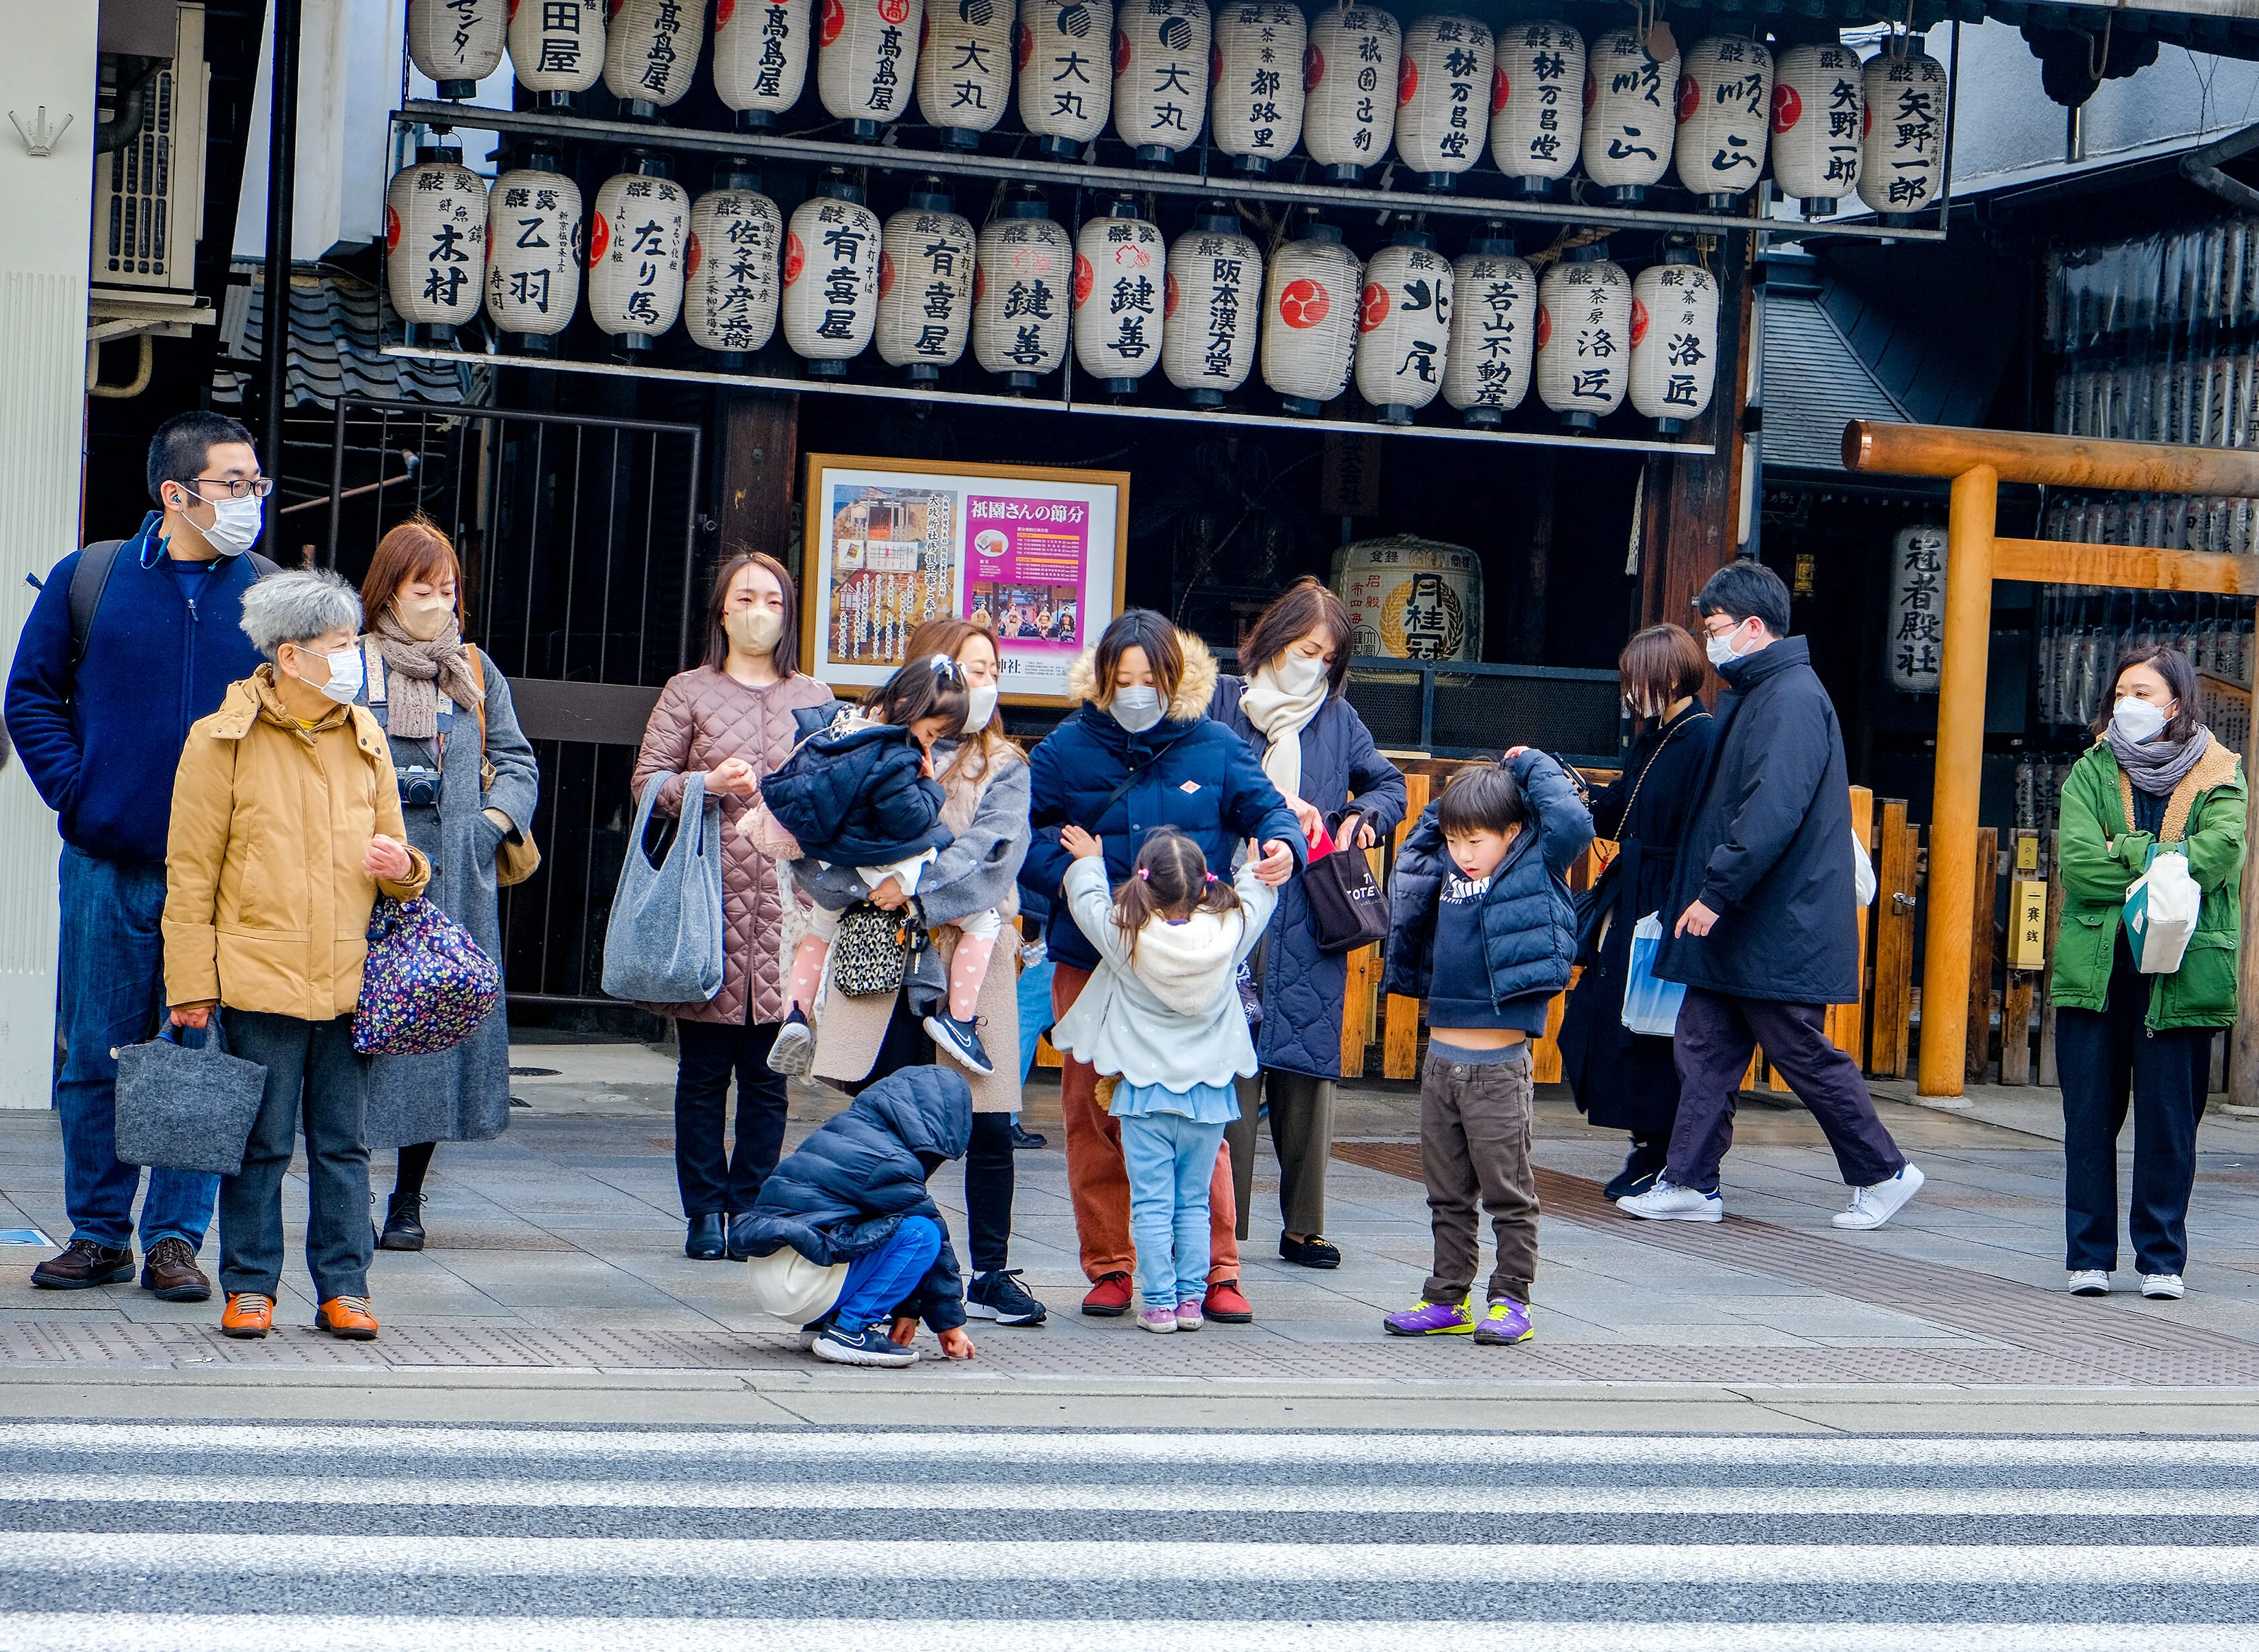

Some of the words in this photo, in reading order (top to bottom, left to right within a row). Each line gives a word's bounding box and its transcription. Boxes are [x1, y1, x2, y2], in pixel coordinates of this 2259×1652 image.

[537, 1, 580, 73] 田屋
[950, 40, 990, 109] 大丸
[1050, 51, 1090, 119] 大丸
[1150, 62, 1190, 131] 大丸
[1440, 47, 1478, 158] 林万昌堂
[1530, 51, 1565, 162] 林万昌堂
[1823, 78, 1859, 188] 矢野一郎
[1888, 88, 1936, 208] 矢野一郎
[424, 224, 469, 306] 木村
[509, 217, 550, 313] 乙羽
[816, 226, 865, 340] 有喜屋
[913, 239, 960, 356] 有喜屋
[1002, 279, 1055, 365] 鍵善
[1106, 275, 1155, 359] 鍵善
[1203, 258, 1242, 378] 阪本漢方堂
[971, 501, 1084, 523] 祇園さんの節分
[1896, 537, 1941, 678] 冠者殿社
[2026, 906, 2039, 943] 賽銭
